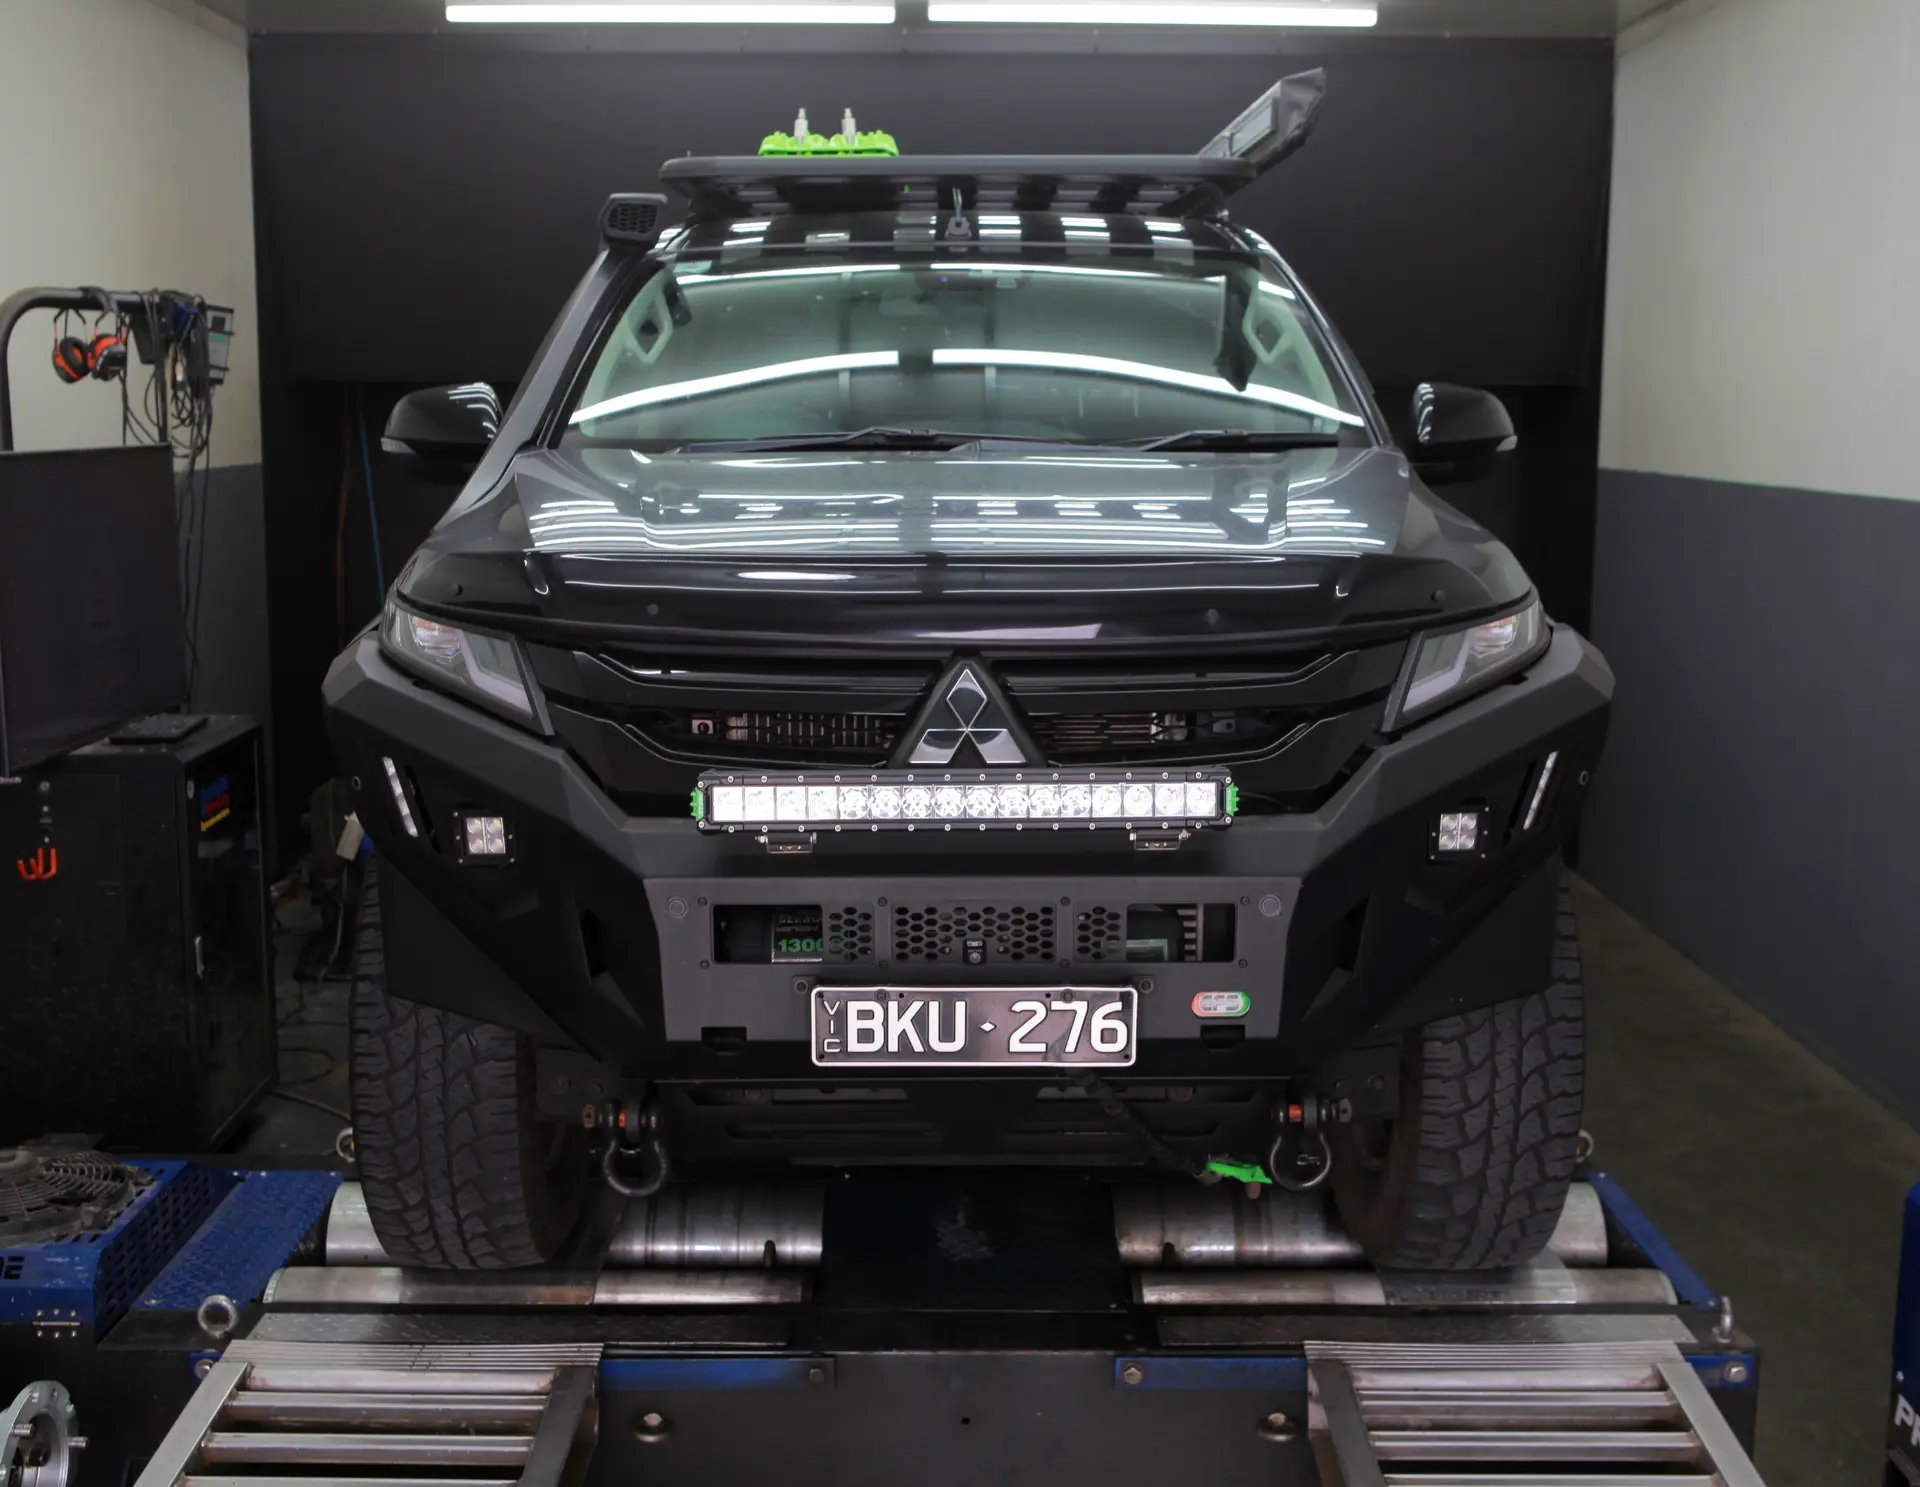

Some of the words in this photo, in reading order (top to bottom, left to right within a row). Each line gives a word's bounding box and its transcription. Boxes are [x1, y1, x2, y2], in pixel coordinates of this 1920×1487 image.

[823, 1000, 840, 1053] VIC
[847, 1000, 967, 1053] BKU
[1009, 1000, 1128, 1053] 276
